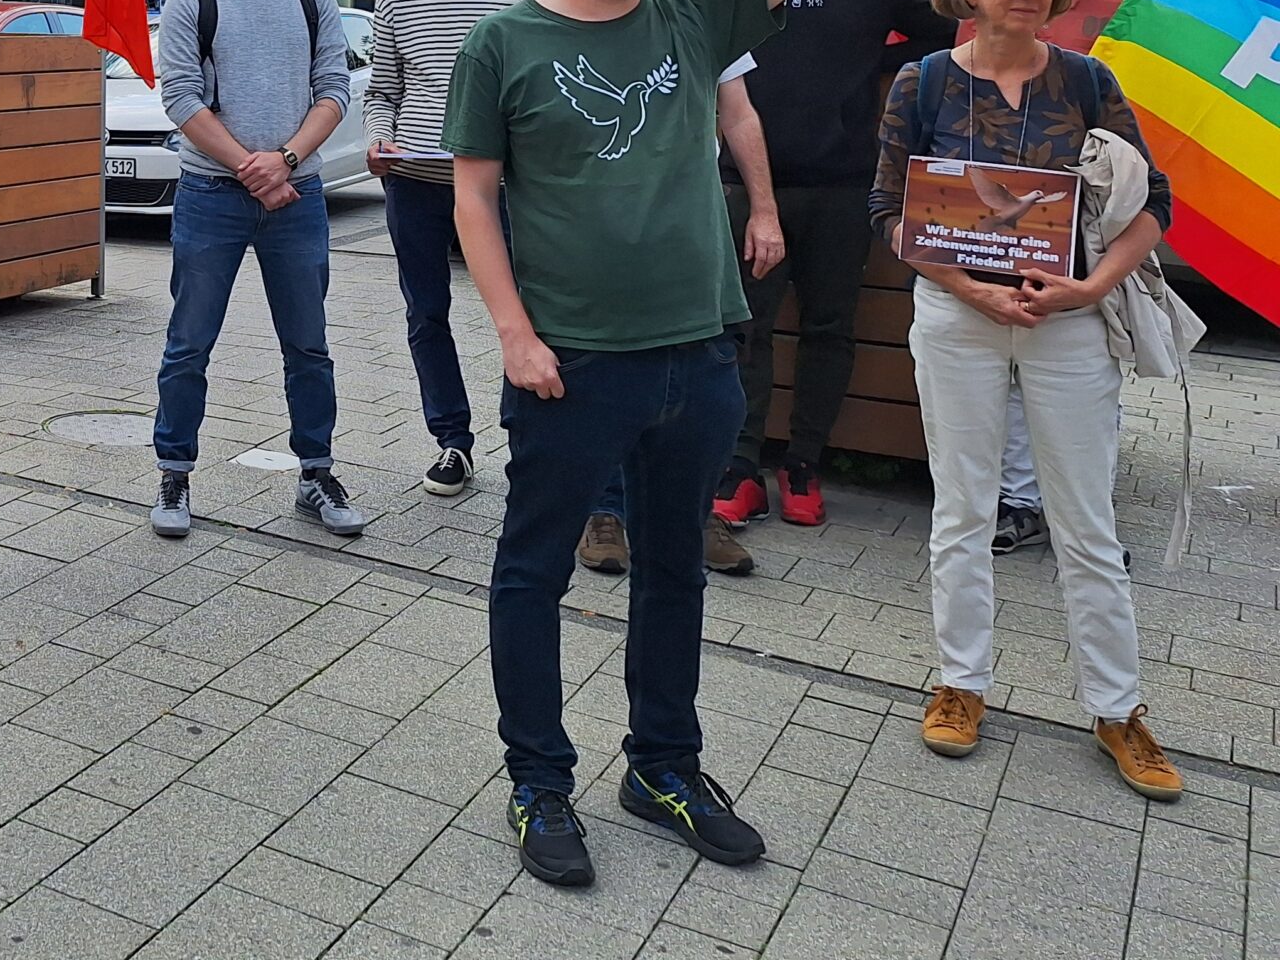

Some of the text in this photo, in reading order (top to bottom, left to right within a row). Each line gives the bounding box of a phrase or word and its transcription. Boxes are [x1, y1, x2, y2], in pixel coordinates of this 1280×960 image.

[112, 160, 133, 175] 512
[925, 224, 1051, 249] Wir brauchen eine
[915, 235, 1060, 263] Zeitenwende für den
[956, 253, 1015, 270] Frieden!
